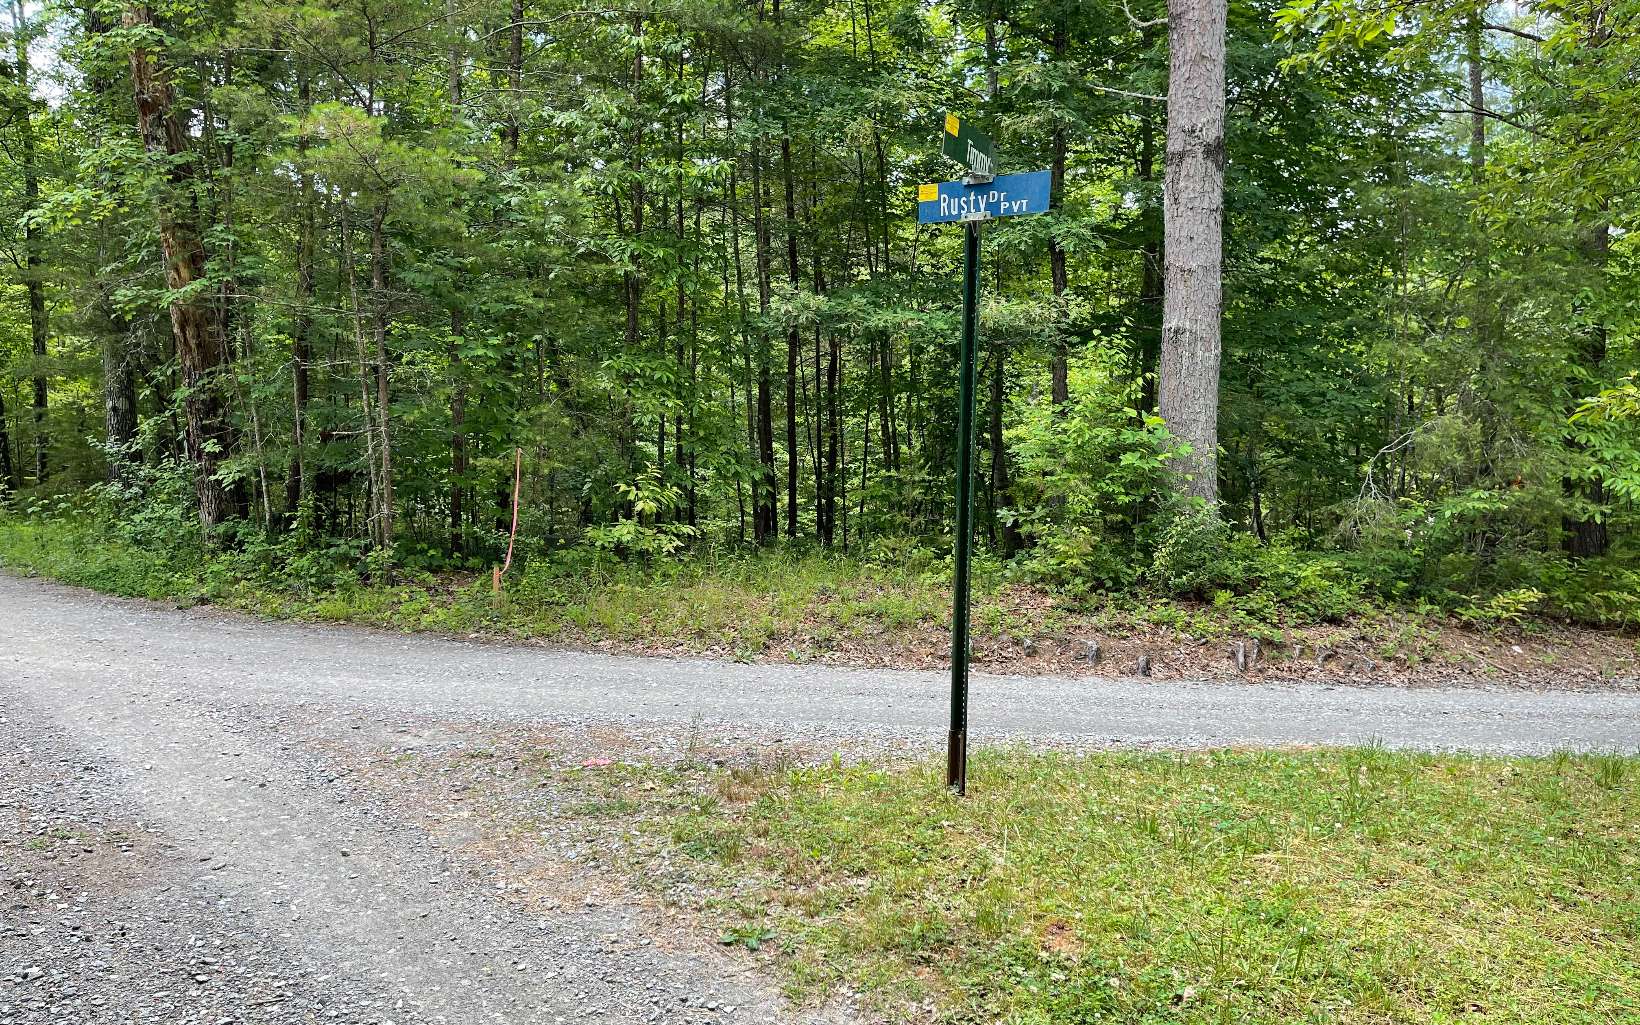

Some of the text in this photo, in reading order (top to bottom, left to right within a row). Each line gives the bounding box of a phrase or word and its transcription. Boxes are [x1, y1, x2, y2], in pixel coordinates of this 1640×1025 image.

[940, 190, 987, 217] Rusty
[989, 190, 1007, 203] Dr
[1000, 199, 1029, 214] PVT
